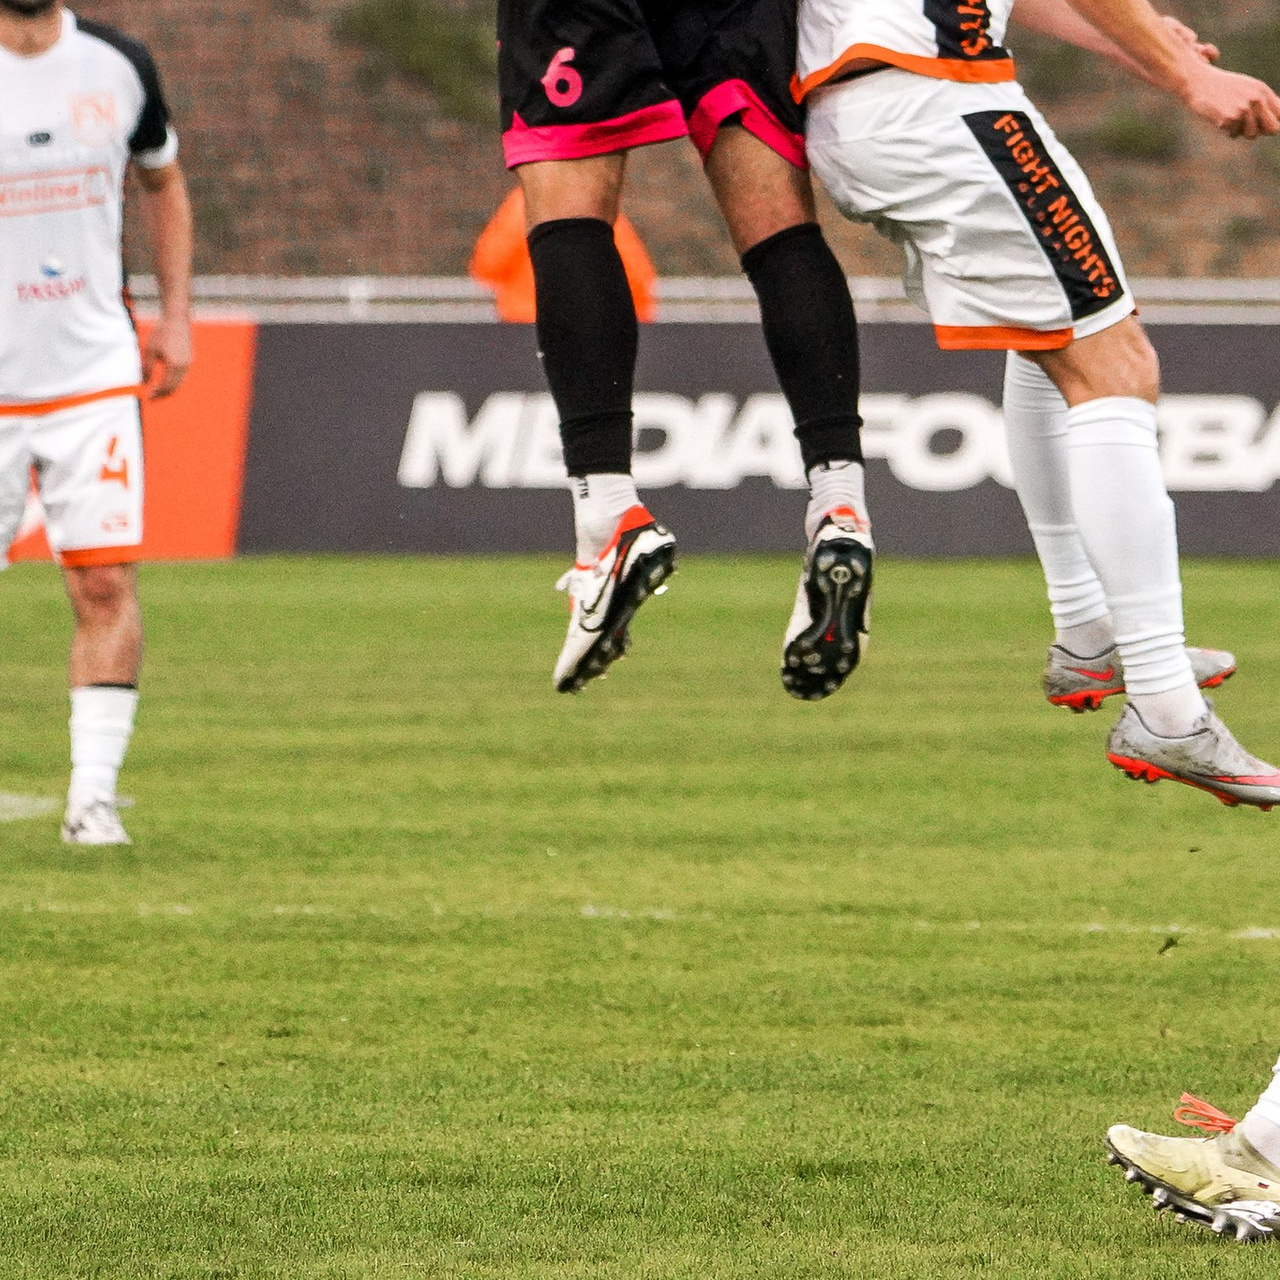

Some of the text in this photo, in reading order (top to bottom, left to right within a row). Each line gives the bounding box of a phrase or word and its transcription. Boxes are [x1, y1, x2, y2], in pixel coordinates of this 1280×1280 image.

[540, 47, 583, 108] 6
[993, 113, 1116, 298] FIGHT NIGHTS
[99, 436, 129, 490] 4
